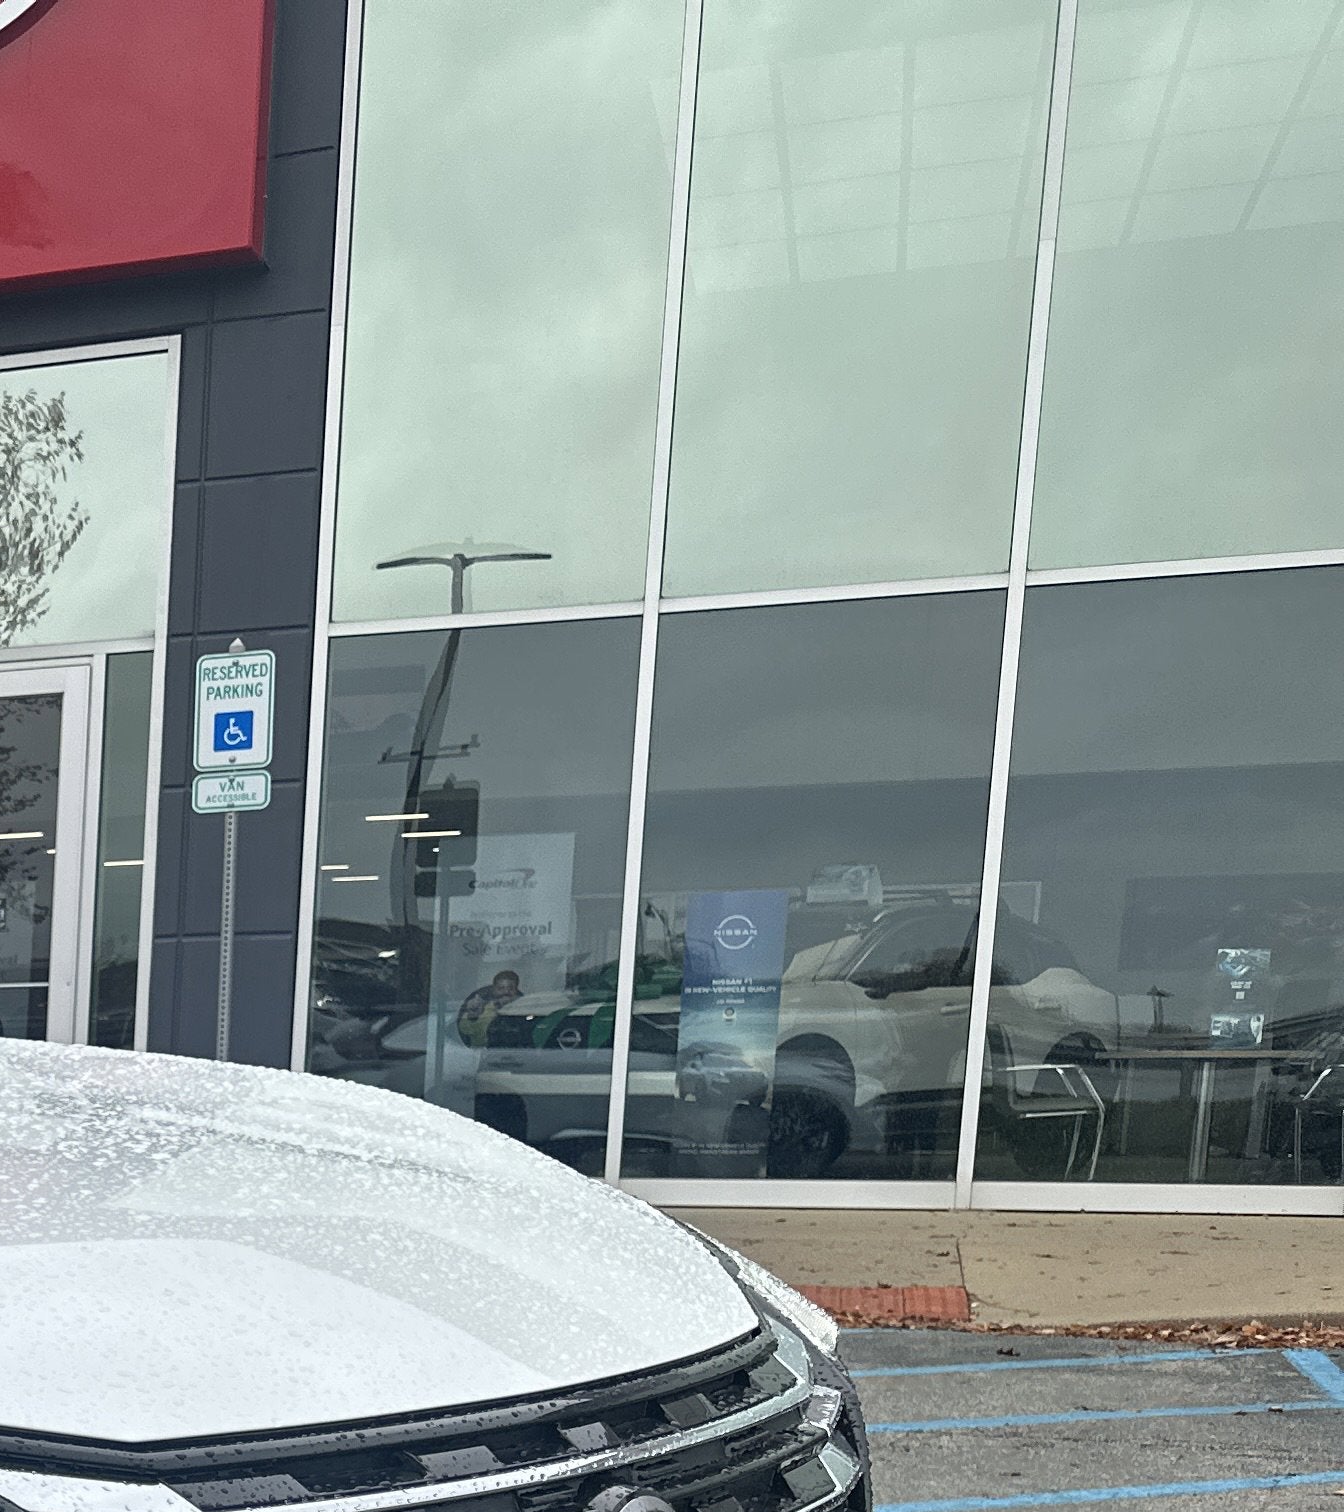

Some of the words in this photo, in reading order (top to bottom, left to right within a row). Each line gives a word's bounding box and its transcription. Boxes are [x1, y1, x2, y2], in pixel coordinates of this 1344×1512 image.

[202, 662, 269, 681] RESERVED
[206, 682, 263, 701] PARKING
[219, 781, 245, 793] VAN
[205, 792, 257, 804] ACCESSIBLE
[449, 921, 552, 940] Pre-Approval
